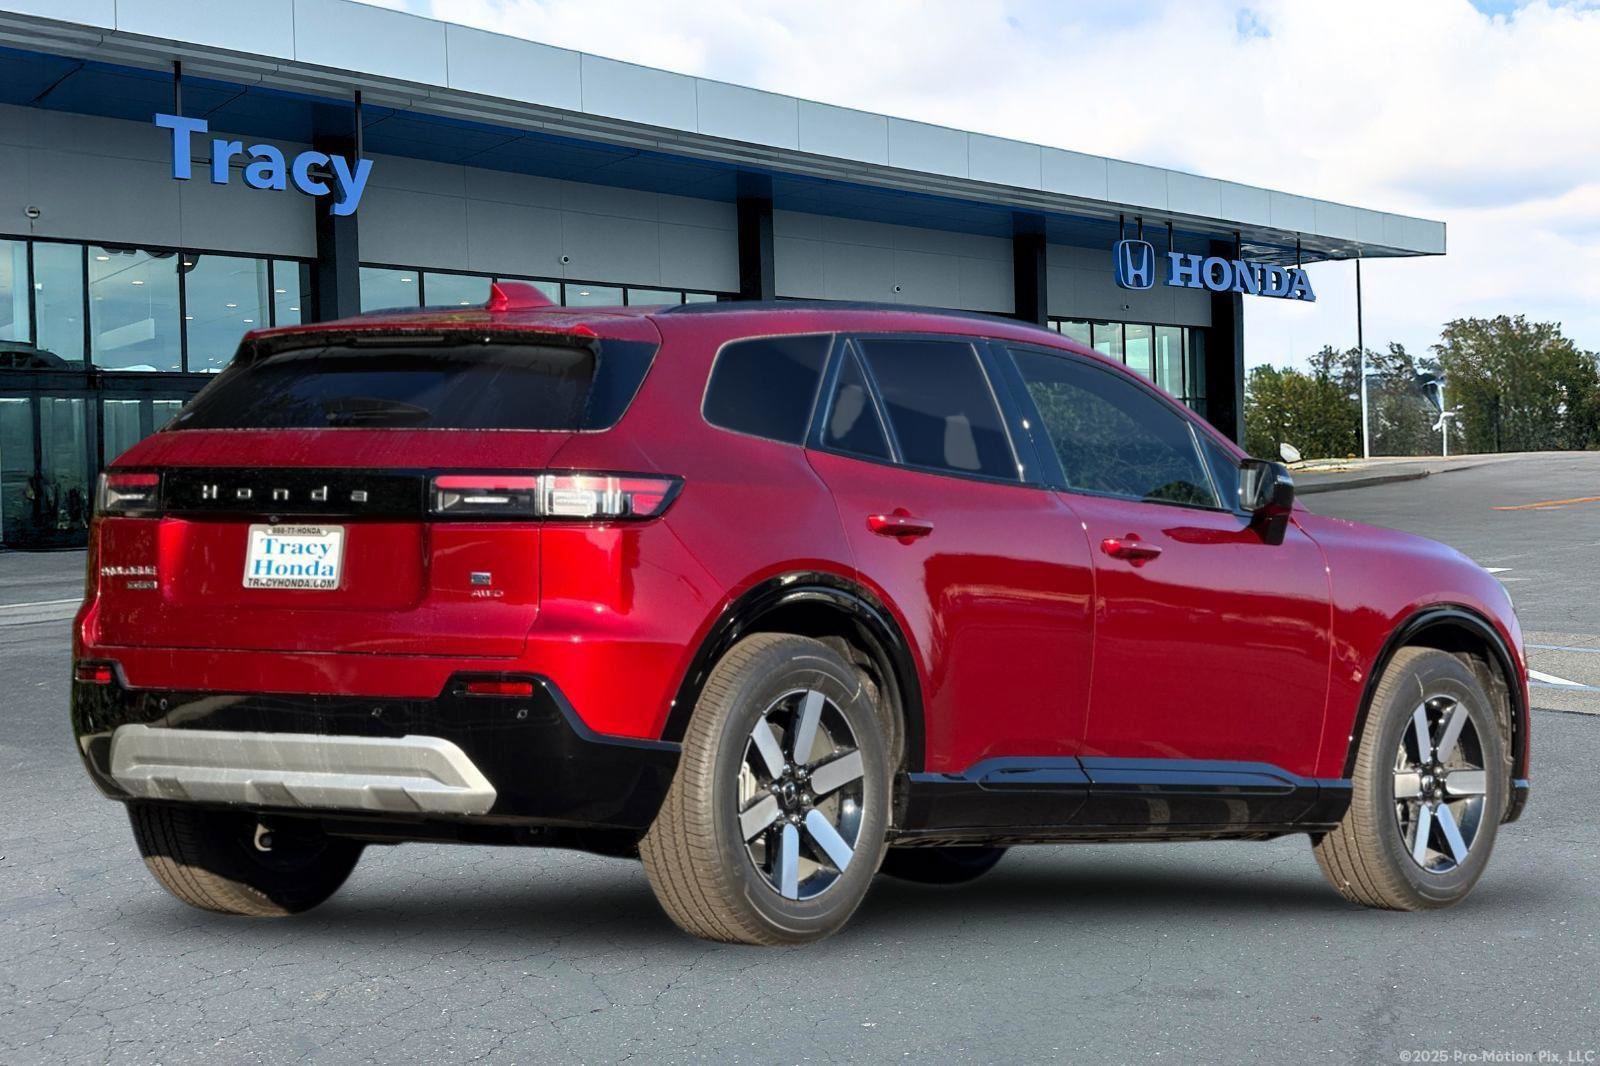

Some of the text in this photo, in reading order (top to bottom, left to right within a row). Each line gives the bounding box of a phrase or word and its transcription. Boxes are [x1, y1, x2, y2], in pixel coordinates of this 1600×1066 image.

[155, 113, 374, 216] Tracy
[1167, 251, 1316, 302] HONDA
[260, 538, 332, 559] Tracy
[254, 560, 334, 576] Honda
